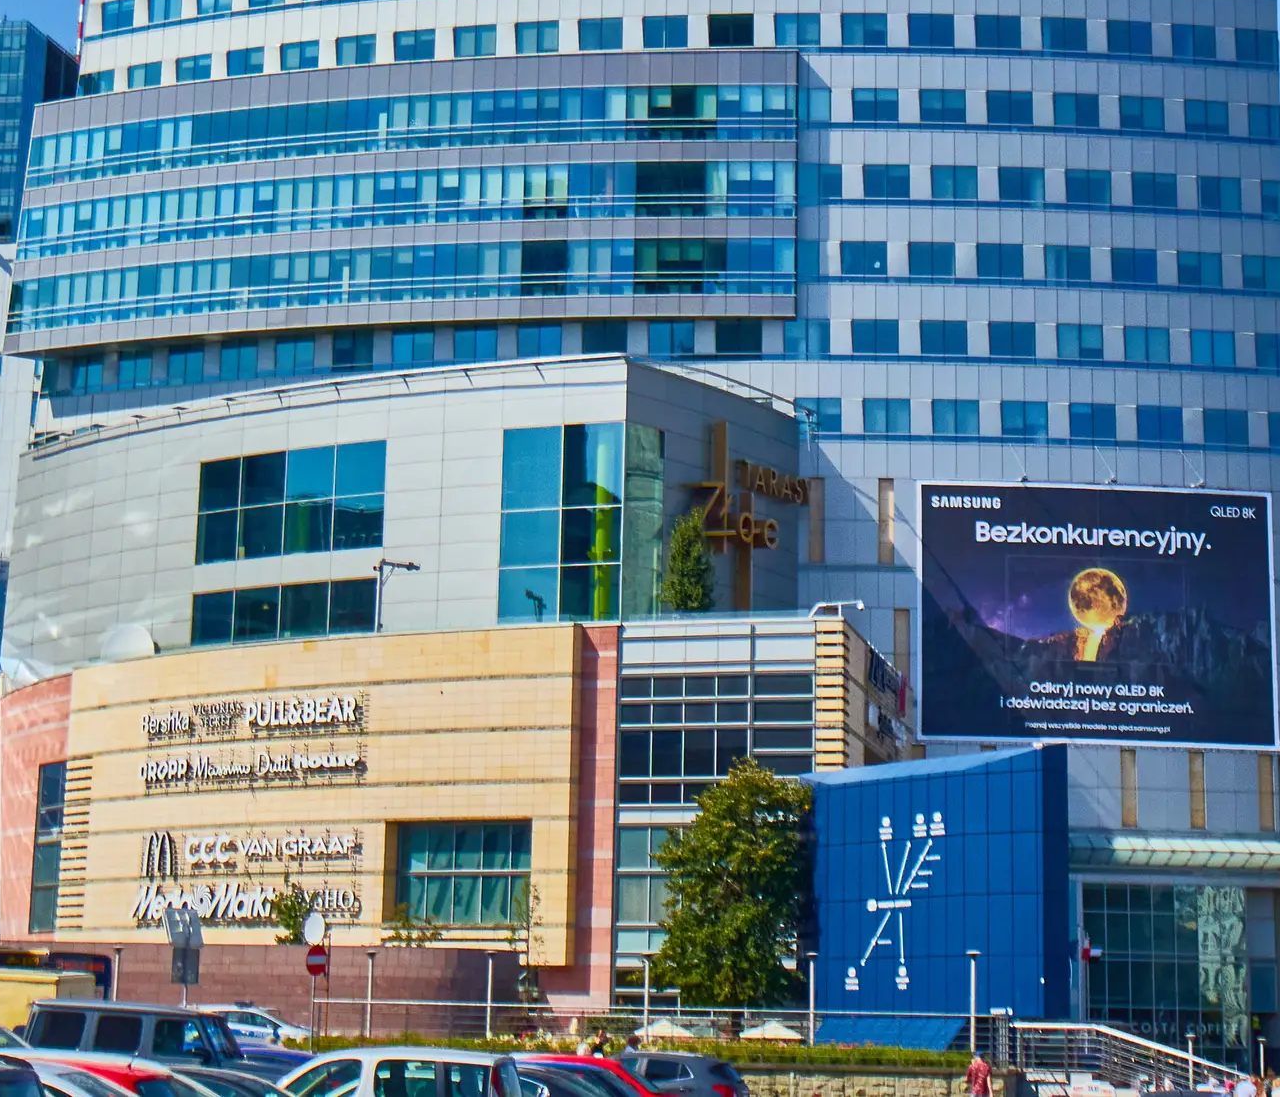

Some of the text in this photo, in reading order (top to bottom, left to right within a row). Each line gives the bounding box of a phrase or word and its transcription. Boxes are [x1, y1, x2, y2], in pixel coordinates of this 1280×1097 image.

[737, 459, 809, 506] TARAS
[931, 495, 1001, 509] SAMSUNG
[1210, 505, 1257, 520] QLED 8K
[975, 520, 1212, 556] Bezkonkurencyjny.
[1030, 681, 1164, 699] Odkryj nowy QLED 8K
[245, 695, 358, 727] PULL&BEAR
[1000, 696, 1195, 716] i doświadczaj bez ograniczeń.
[141, 711, 190, 733] Bershka
[138, 758, 188, 782] CROPP
[193, 751, 293, 779] Massimo Dutti
[185, 835, 232, 863] CCC
[239, 835, 356, 856] VAN GRAAF
[298, 888, 355, 911] YSHO
